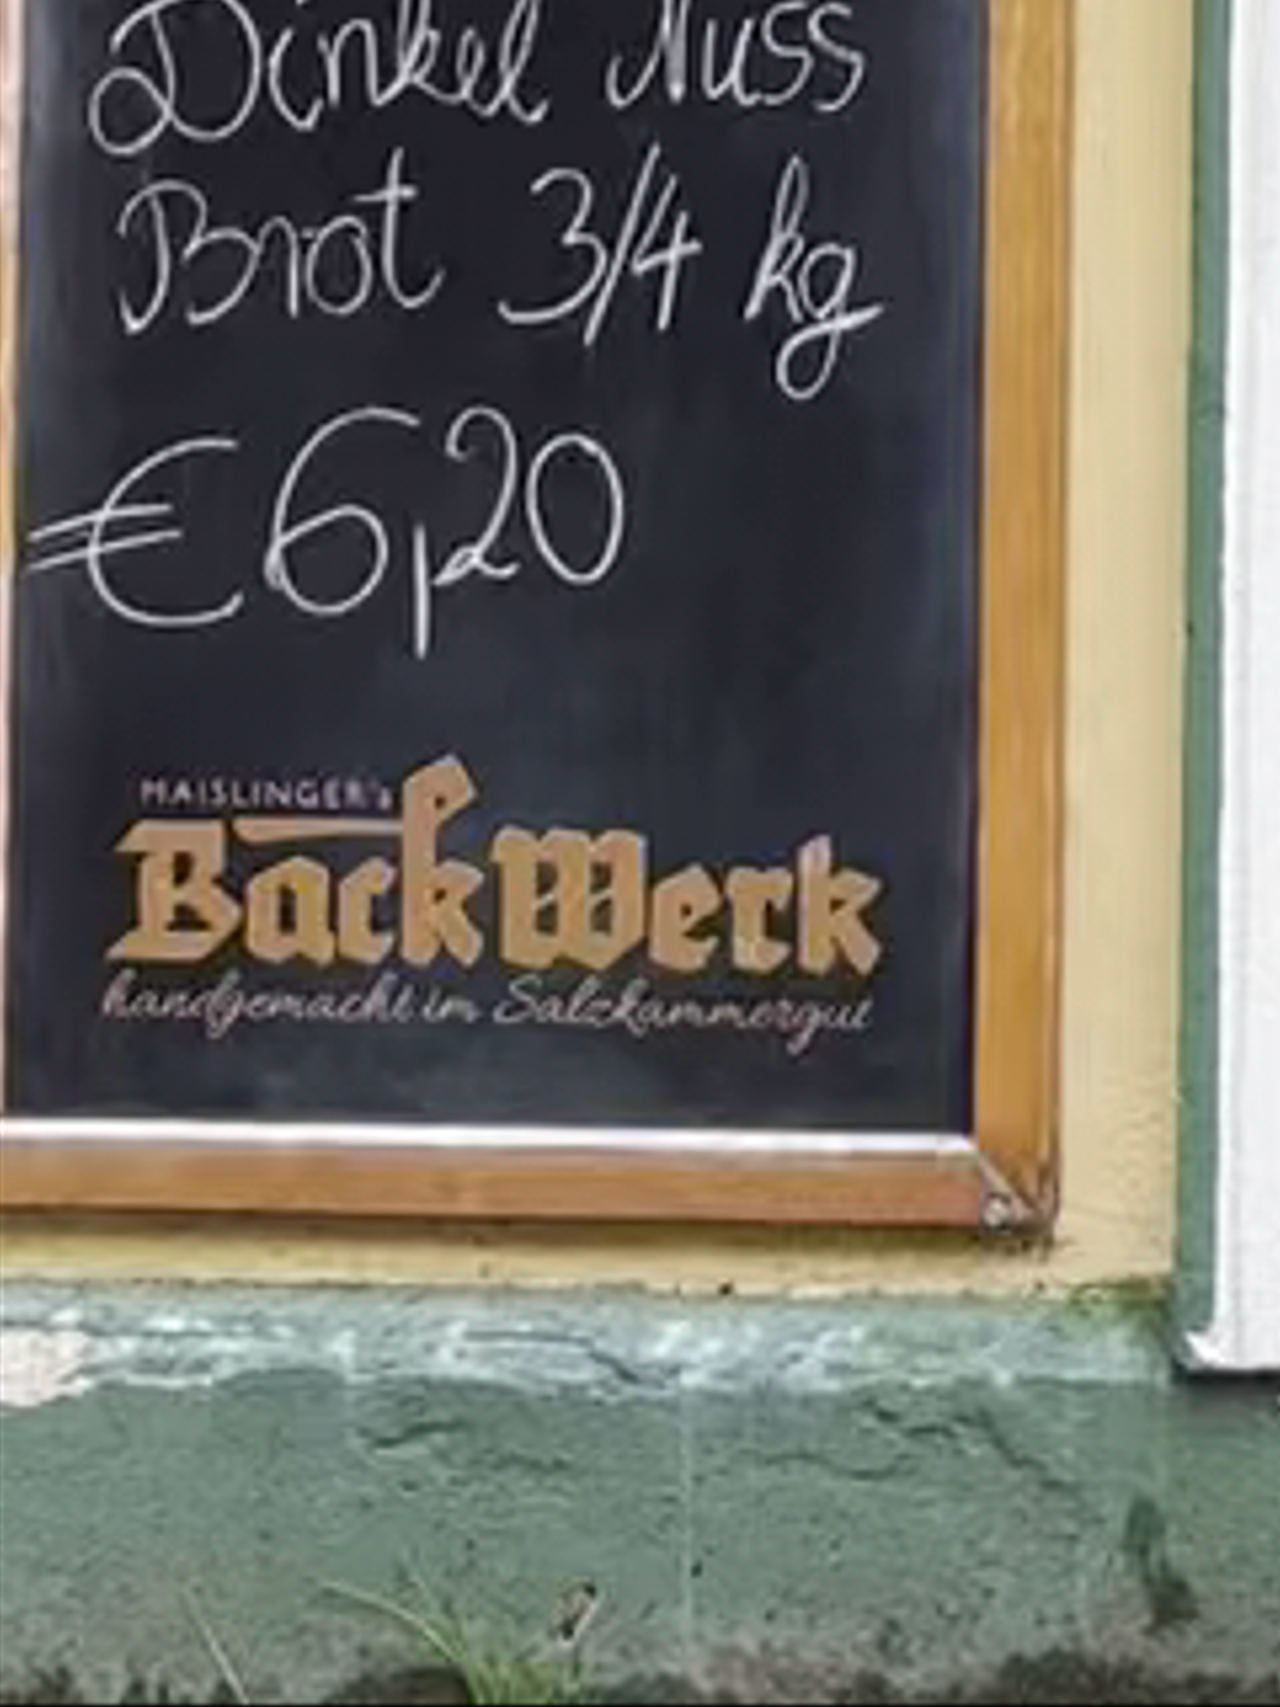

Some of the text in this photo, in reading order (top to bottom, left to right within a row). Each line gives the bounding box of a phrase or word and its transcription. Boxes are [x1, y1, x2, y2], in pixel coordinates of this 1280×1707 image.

[118, 142, 886, 400] Brot 3/4 kg
[102, 966, 874, 1053] handgemacht im Salzkammergut
